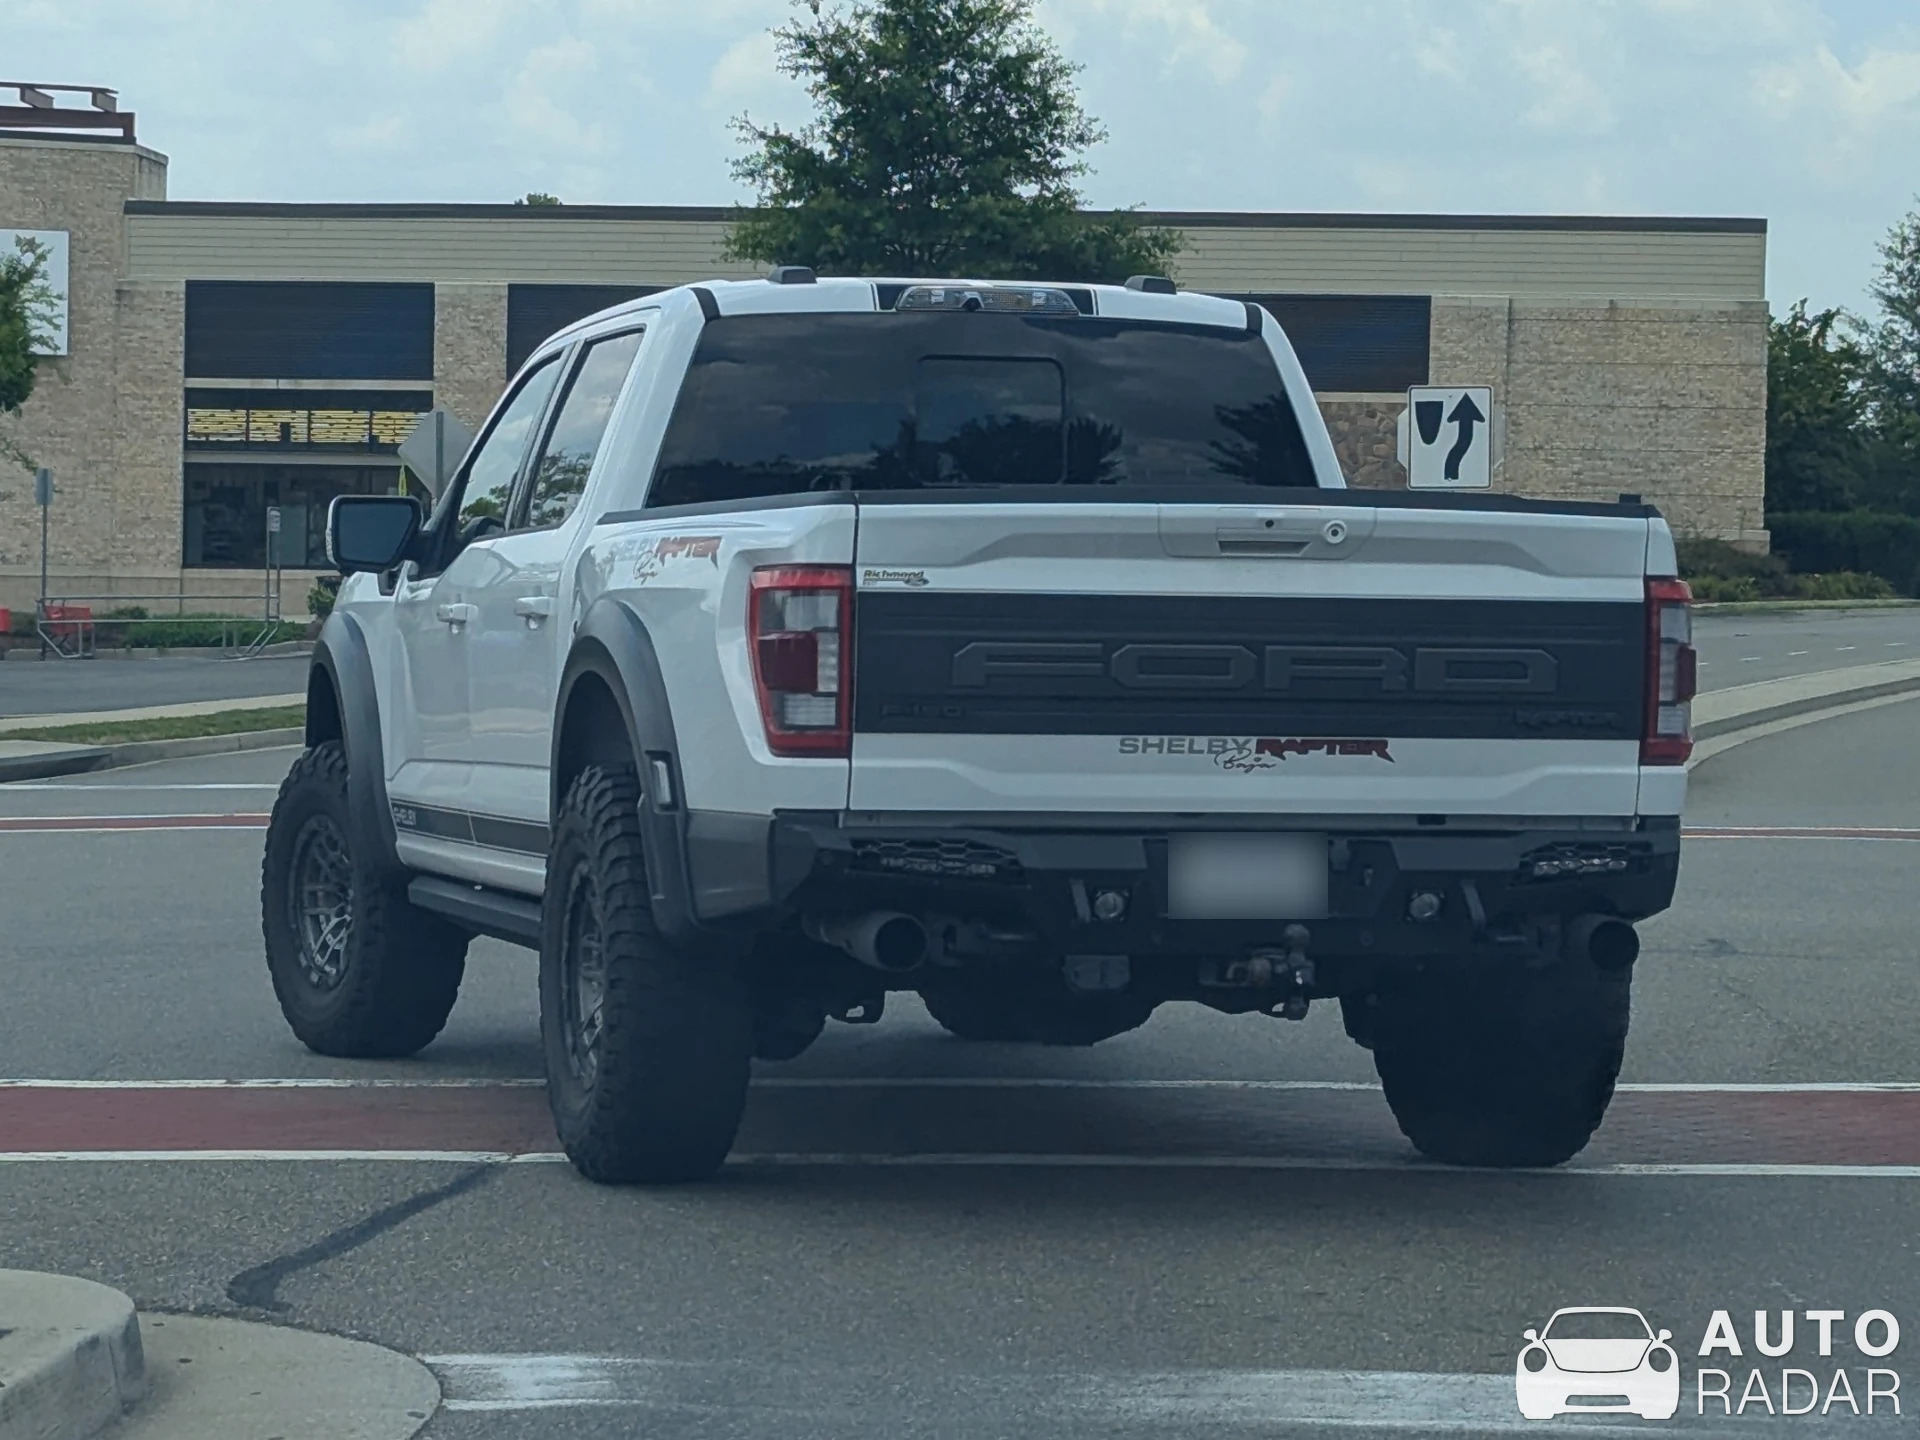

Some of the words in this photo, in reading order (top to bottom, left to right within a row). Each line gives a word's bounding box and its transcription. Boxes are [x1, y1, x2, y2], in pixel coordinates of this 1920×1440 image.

[864, 569, 925, 579] Richmond
[953, 641, 1559, 694] FORD
[1118, 736, 1252, 755] SHELBY
[1254, 737, 1396, 764] RAPTOR
[1213, 747, 1276, 773] Baja
